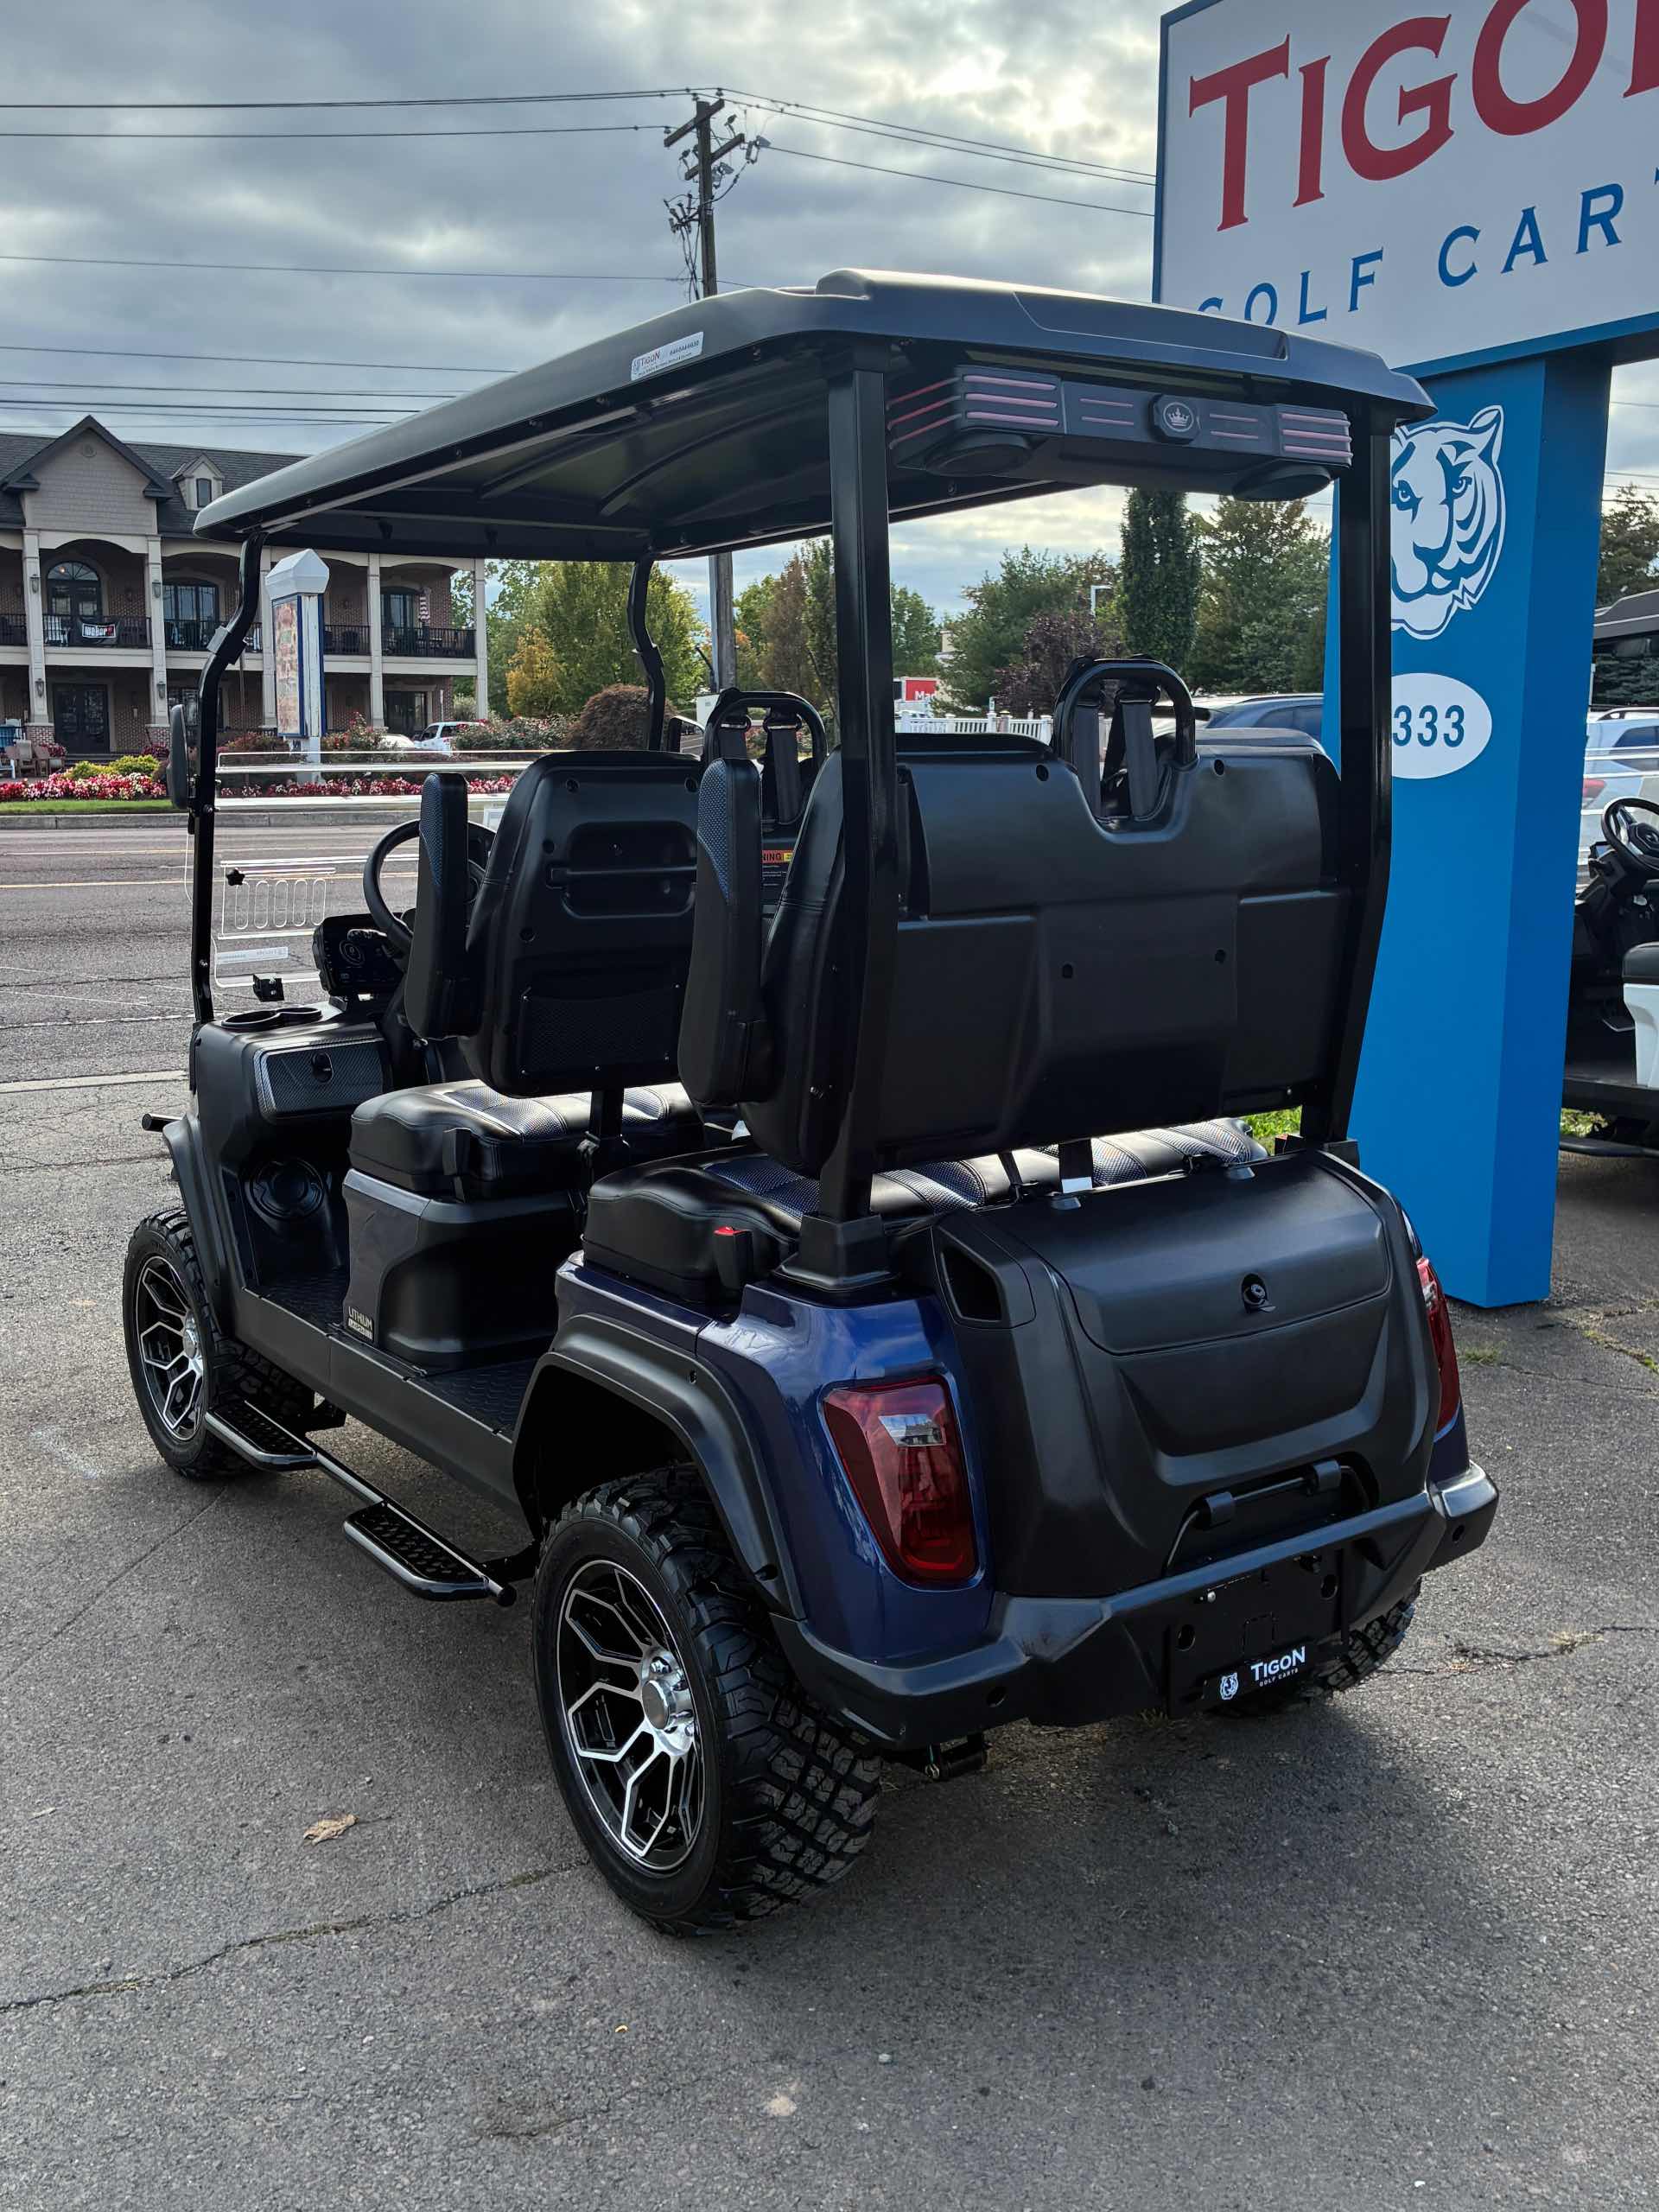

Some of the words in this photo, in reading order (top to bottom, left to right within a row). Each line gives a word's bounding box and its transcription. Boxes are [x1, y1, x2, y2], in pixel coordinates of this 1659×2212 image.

[1189, 0, 1659, 232] TIGO
[1438, 167, 1659, 287] CAR
[348, 1306, 372, 1331] LITHIUM
[1250, 1645, 1306, 1681] TIGON
[1259, 1676, 1277, 1687] GOLF
[1278, 1667, 1299, 1680] CARTS
